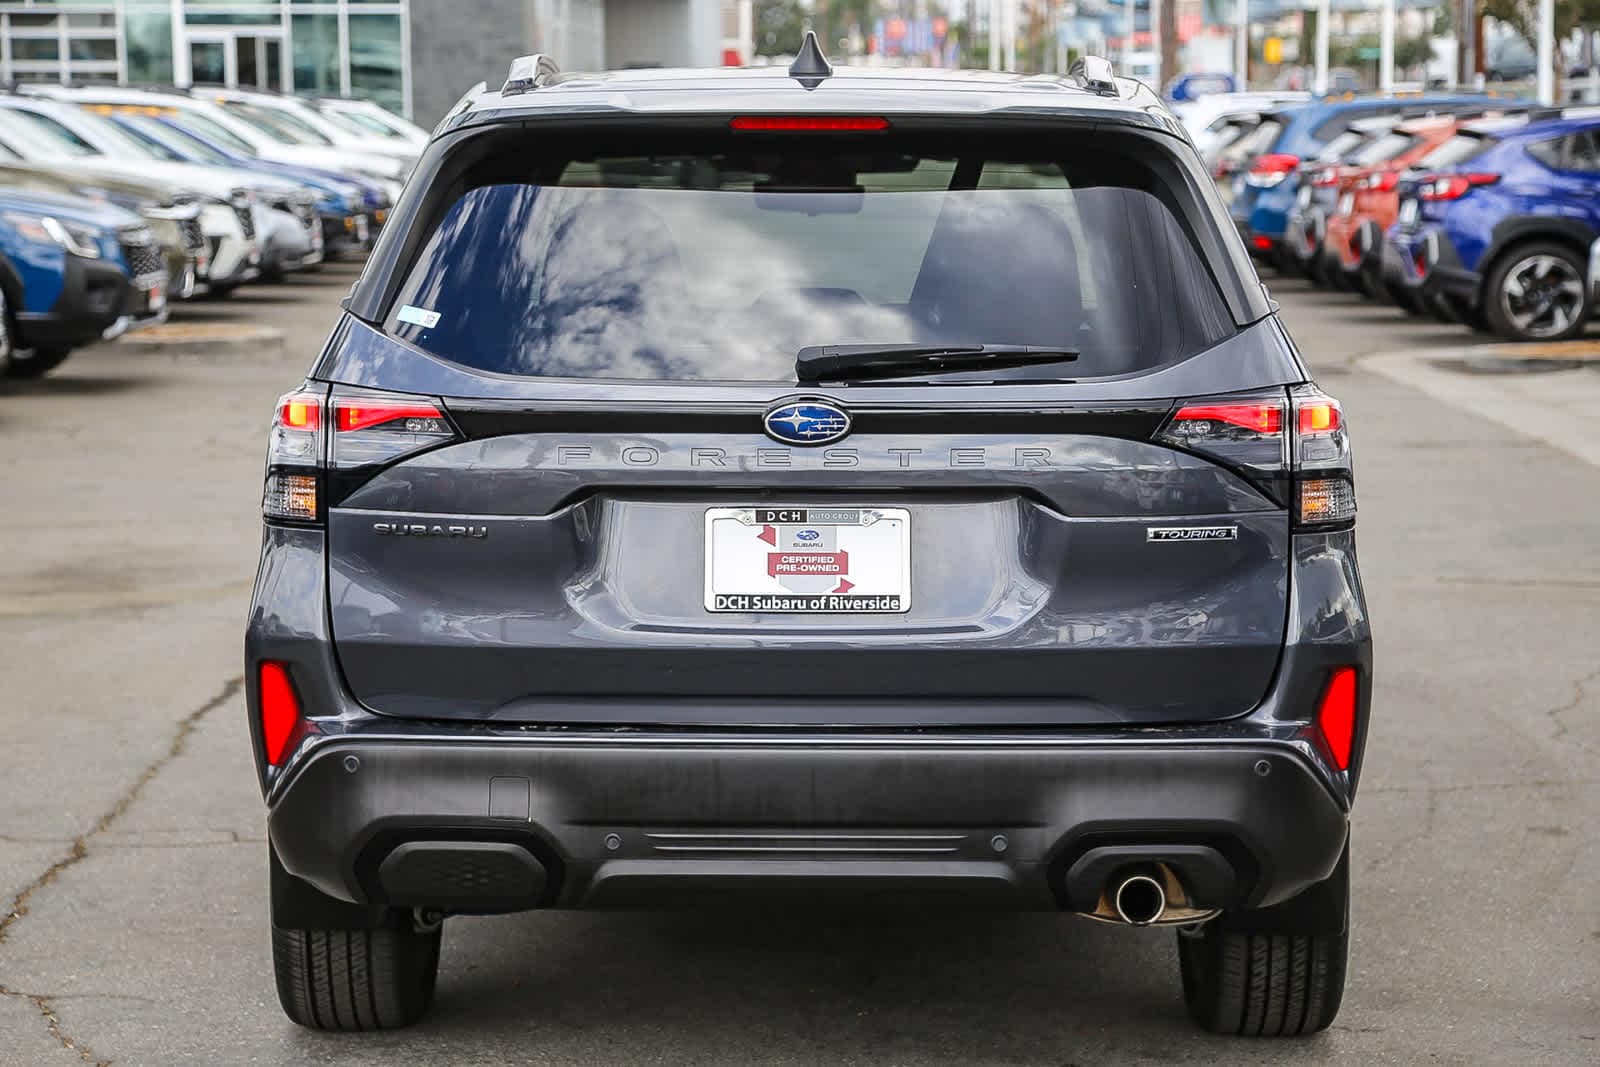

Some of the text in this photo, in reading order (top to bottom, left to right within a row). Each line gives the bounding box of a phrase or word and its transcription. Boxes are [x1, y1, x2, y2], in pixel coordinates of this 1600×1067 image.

[557, 446, 1051, 467] FORESTER
[767, 511, 801, 521] DCH
[810, 512, 859, 520] AUTO GROUP
[373, 523, 488, 537] SUBARU
[1159, 529, 1227, 539] TOURING
[781, 555, 834, 563] CERTIFIED
[776, 564, 840, 572] PRE-OWNED
[716, 595, 899, 609] DCH Subaru of Riverside
